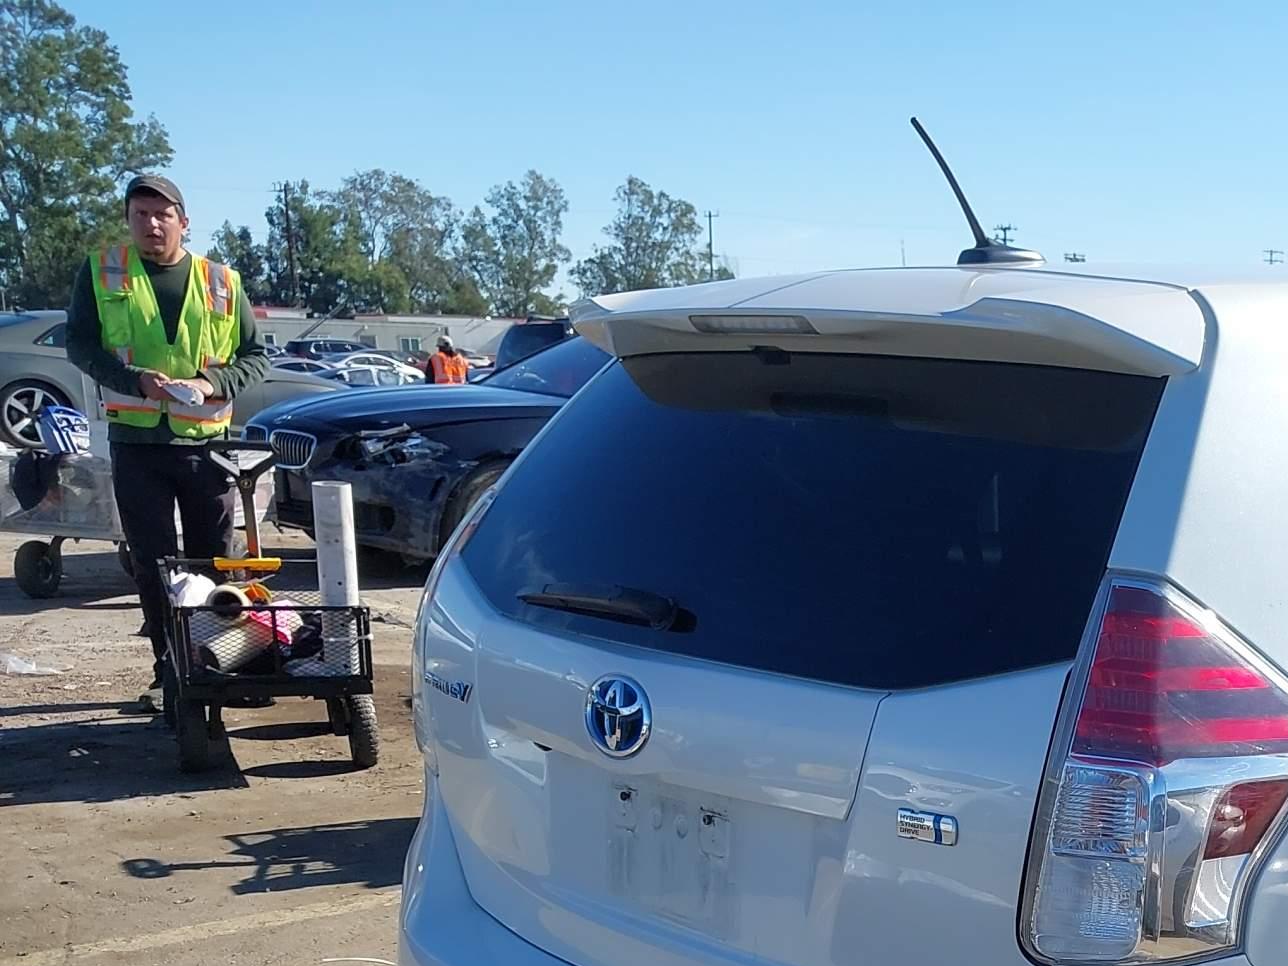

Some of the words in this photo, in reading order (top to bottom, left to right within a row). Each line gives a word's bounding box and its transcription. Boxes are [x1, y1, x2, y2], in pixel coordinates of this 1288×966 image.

[899, 813, 926, 824] HYBRID
[899, 820, 933, 832] SYNERGY
[899, 827, 920, 836] DRIVE
